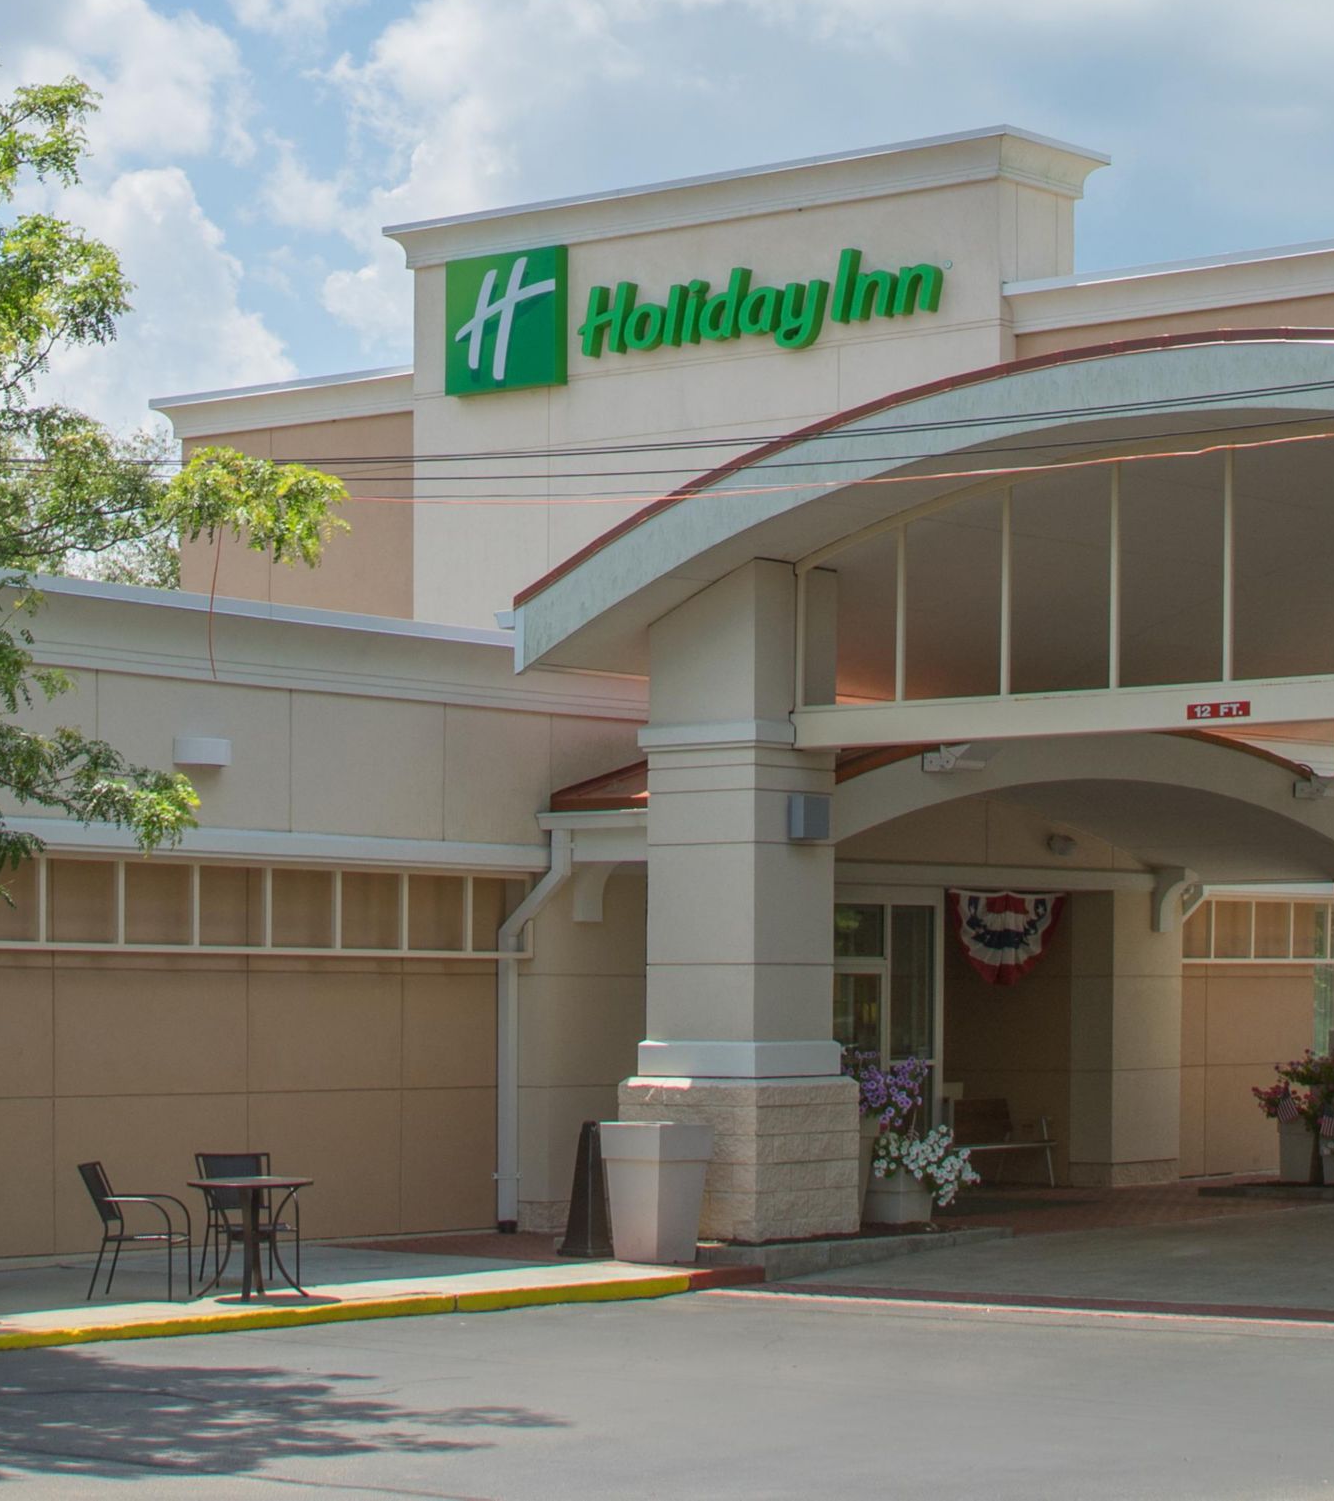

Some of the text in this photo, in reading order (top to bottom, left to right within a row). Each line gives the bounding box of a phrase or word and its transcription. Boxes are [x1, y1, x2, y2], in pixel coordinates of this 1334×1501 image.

[577, 248, 944, 359] Holiday Inn
[1194, 703, 1244, 718] 12 FT.
